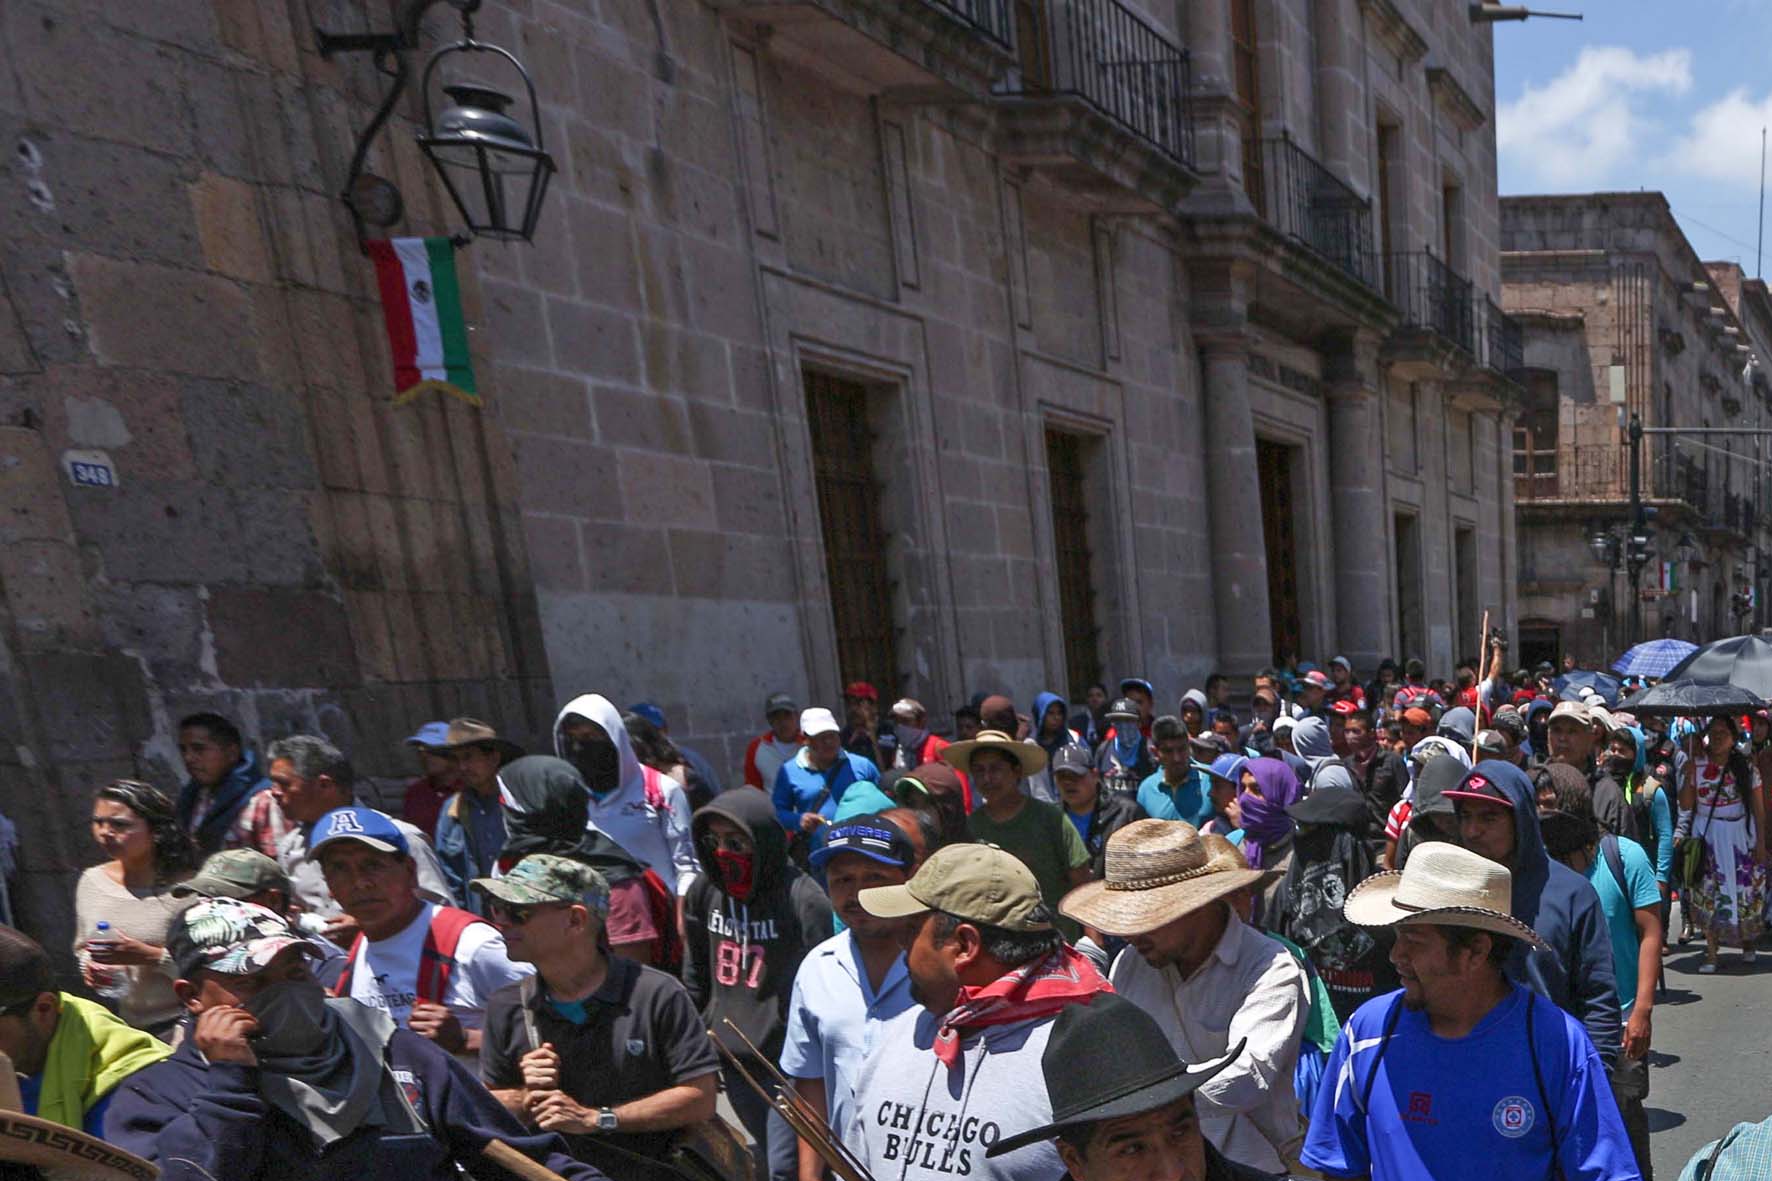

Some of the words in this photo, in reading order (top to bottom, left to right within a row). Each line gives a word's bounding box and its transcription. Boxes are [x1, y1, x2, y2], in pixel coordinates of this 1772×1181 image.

[327, 810, 364, 836] A
[877, 1100, 1001, 1148] CHICAGO
[883, 1133, 972, 1176] BULLS
